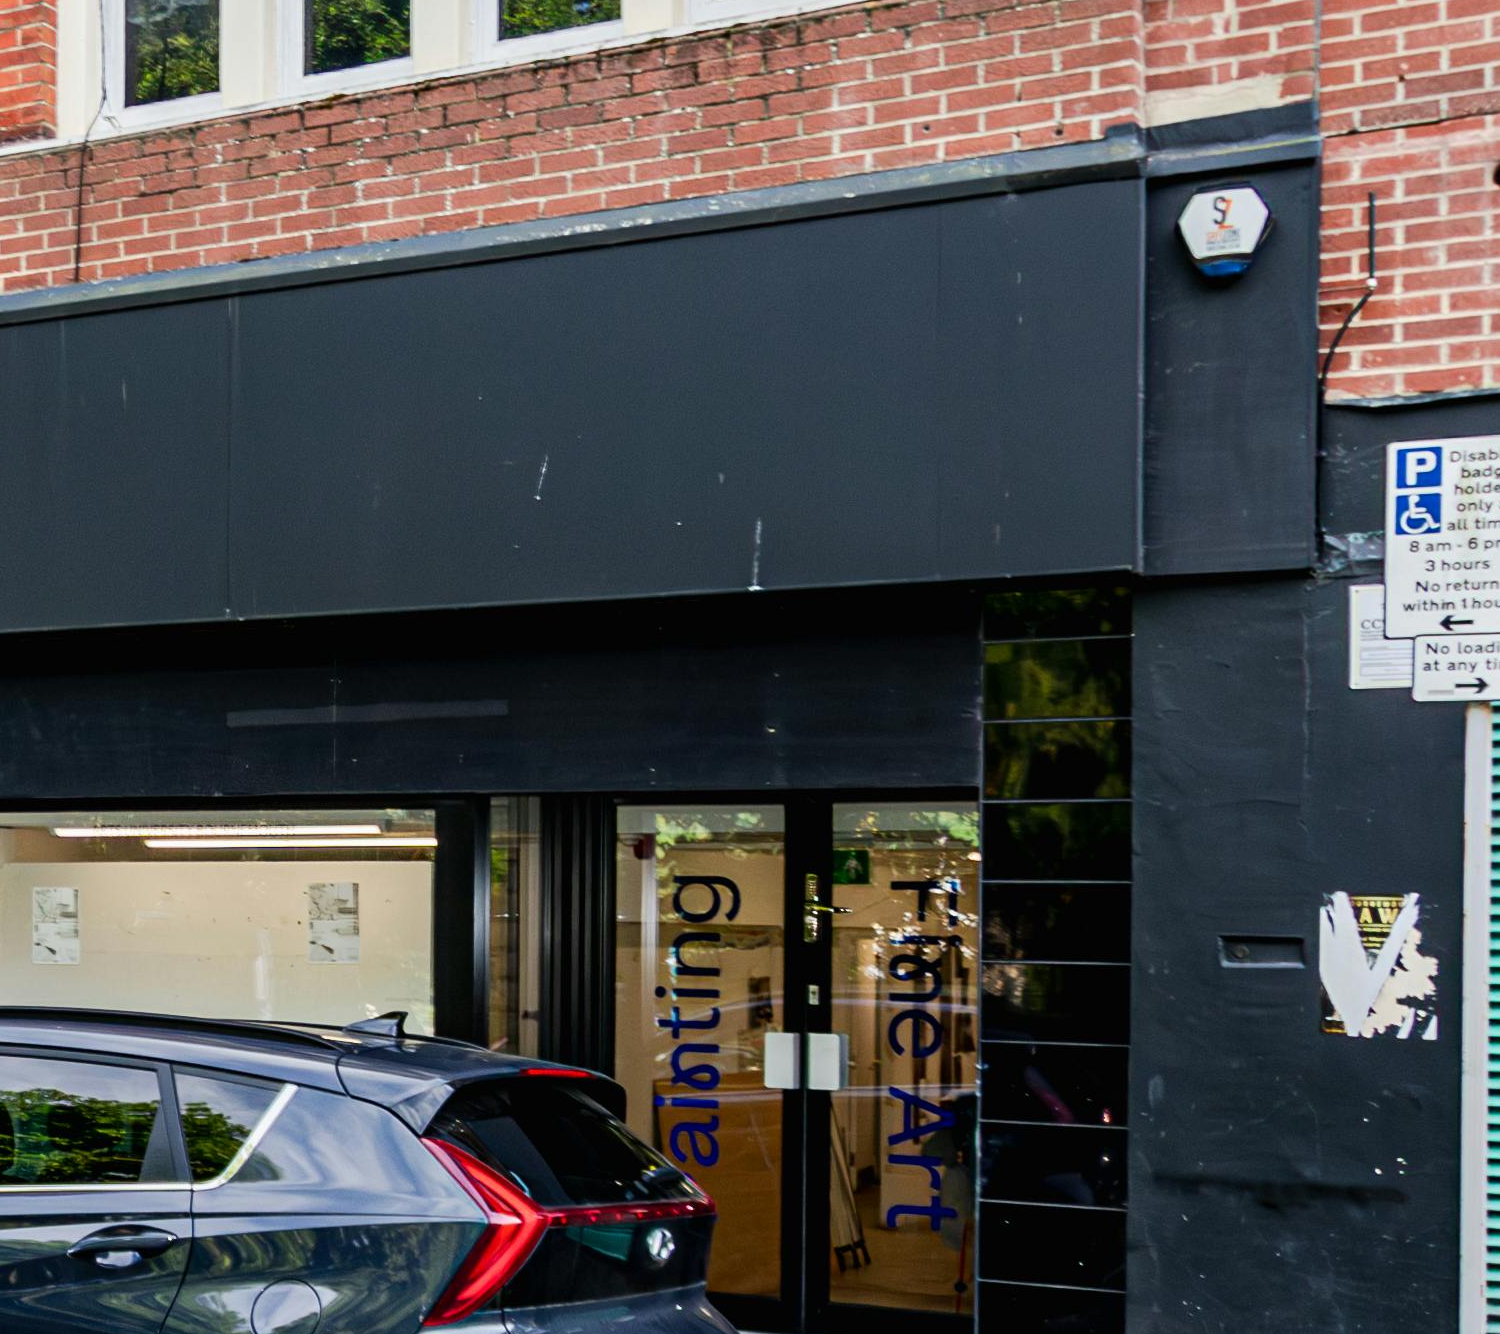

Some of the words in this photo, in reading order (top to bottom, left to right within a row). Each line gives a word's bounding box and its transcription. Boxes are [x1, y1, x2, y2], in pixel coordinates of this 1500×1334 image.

[1405, 450, 1437, 486] P
[1457, 498, 1493, 513] only
[1447, 517, 1469, 531] all
[1409, 541, 1420, 553] 8
[1425, 542, 1452, 552] am
[1468, 537, 1478, 549] 6
[1425, 560, 1435, 572] 3
[1441, 559, 1490, 571] hours
[1416, 581, 1440, 593] No
[1446, 579, 1500, 592] return
[1403, 598, 1455, 612] within
[1461, 598, 1468, 609] 1
[1361, 618, 1384, 630] CC
[1426, 643, 1450, 655] No
[1423, 660, 1440, 671] at
[1447, 661, 1478, 673] any
[888, 879, 962, 1059] Fine
[655, 875, 741, 1181] ainting
[886, 1086, 958, 1232] Art
